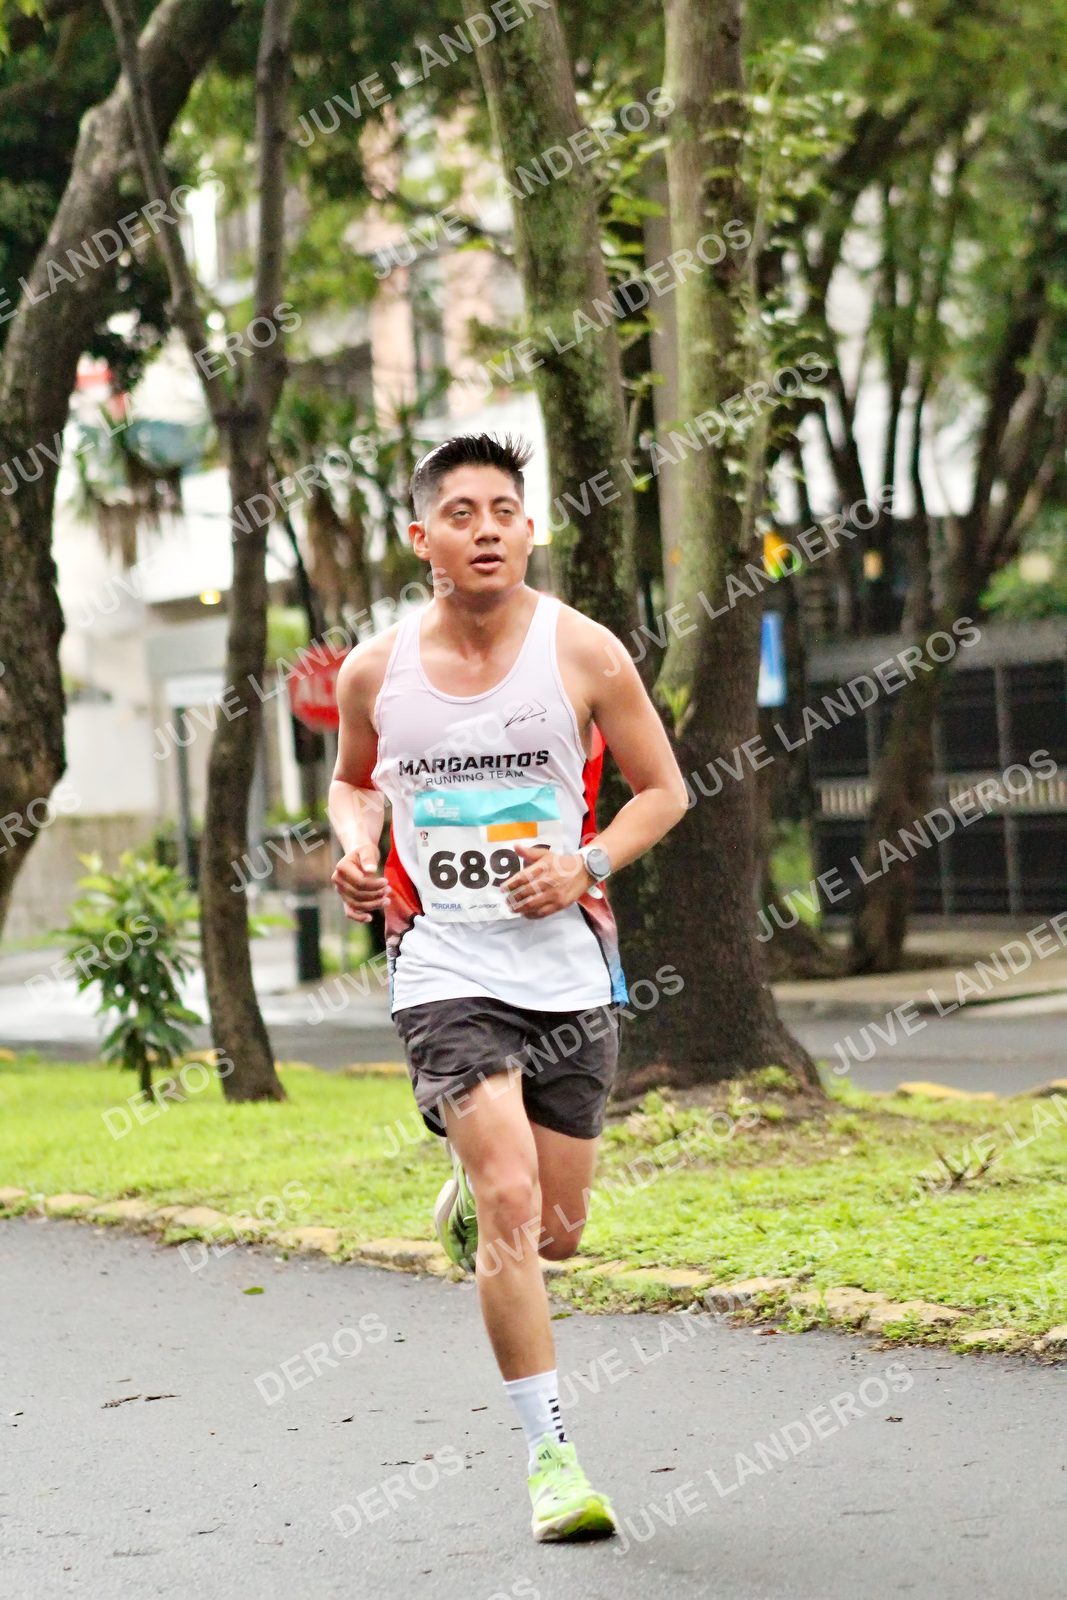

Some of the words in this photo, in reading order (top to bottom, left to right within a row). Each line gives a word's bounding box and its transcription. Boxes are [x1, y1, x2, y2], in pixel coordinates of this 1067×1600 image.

[399, 750, 549, 777] MARGARITO'S
[425, 771, 484, 787] RUNNING
[489, 769, 525, 780] TEAM
[429, 843, 551, 890] 689
